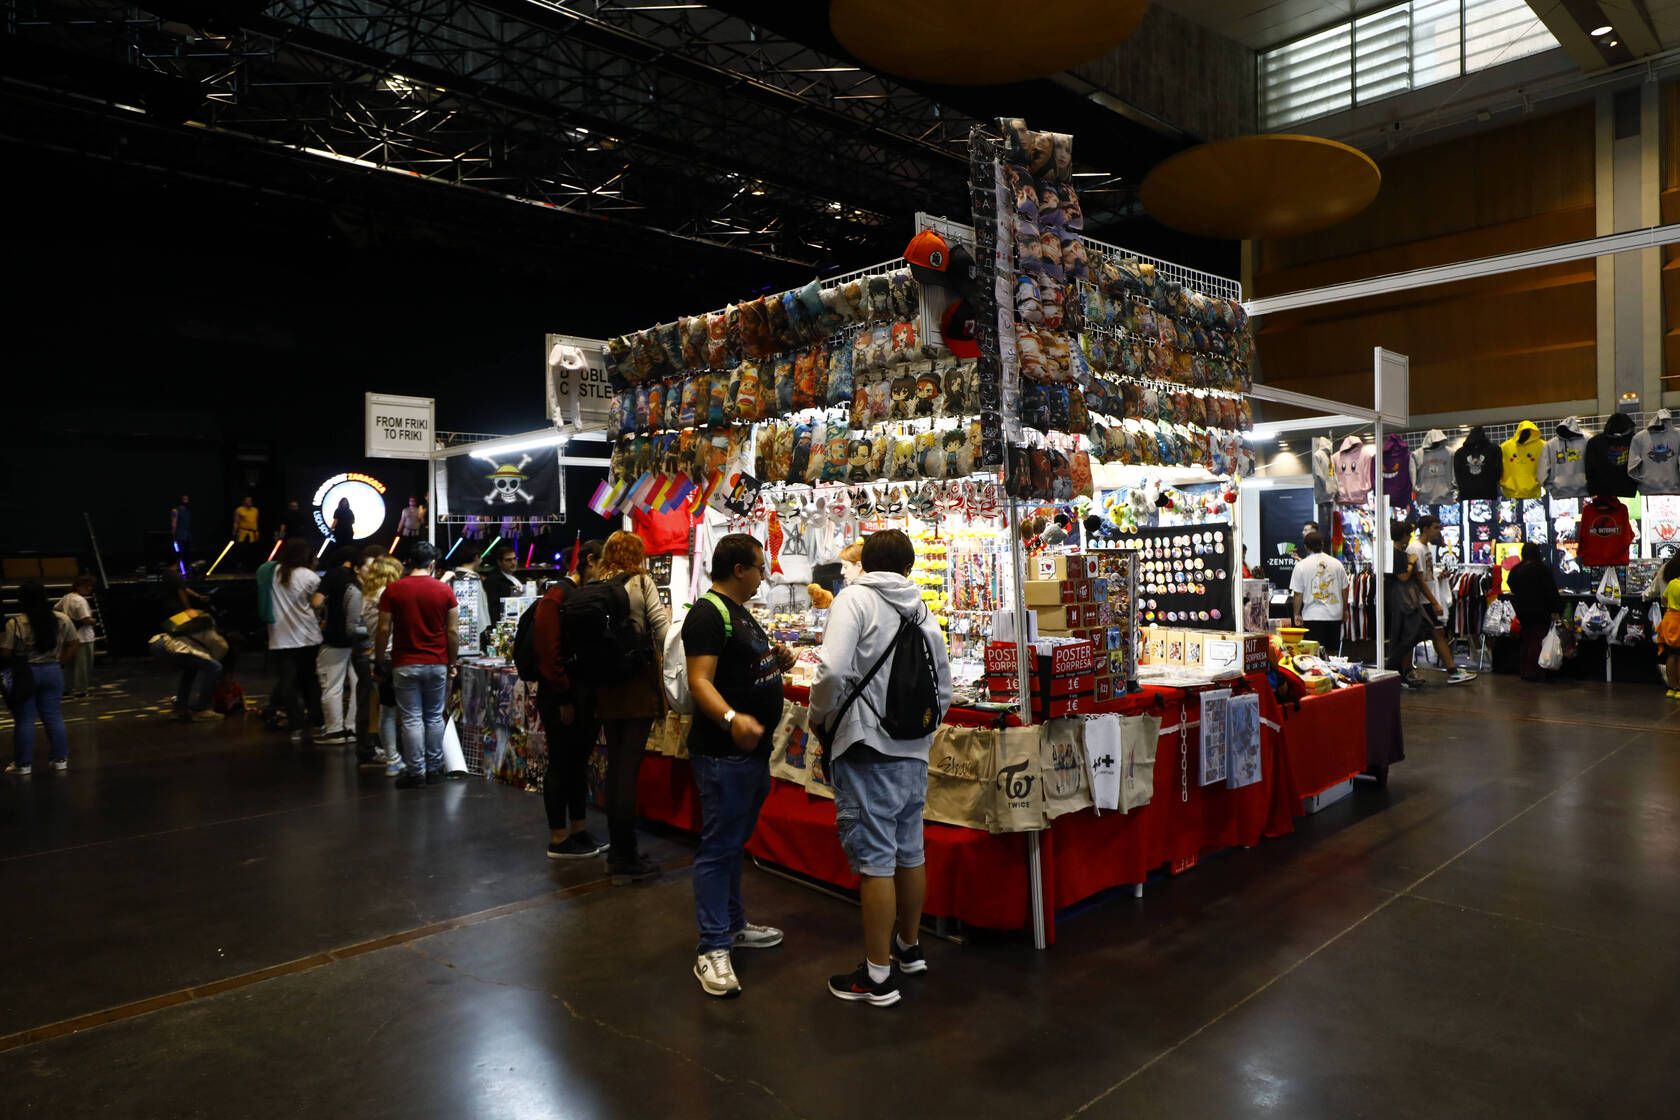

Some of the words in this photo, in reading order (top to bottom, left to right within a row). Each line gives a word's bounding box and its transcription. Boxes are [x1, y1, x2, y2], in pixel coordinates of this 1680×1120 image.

[560, 381, 613, 399] CSTLE
[376, 416, 402, 428] FROM
[405, 418, 428, 430] FRIKI
[384, 428, 397, 440] TO
[399, 429, 422, 441] FRIKI
[1245, 640, 1257, 654] KIT
[987, 648, 1033, 661] POSTR
[1055, 646, 1091, 662] POSTER
[989, 661, 1034, 671] SORPRA
[1055, 659, 1092, 673] SORPRESA
[1006, 678, 1020, 690] 1€
[1067, 677, 1080, 690] 1€
[1066, 699, 1079, 712] 1€
[1007, 800, 1031, 809] TWICE
